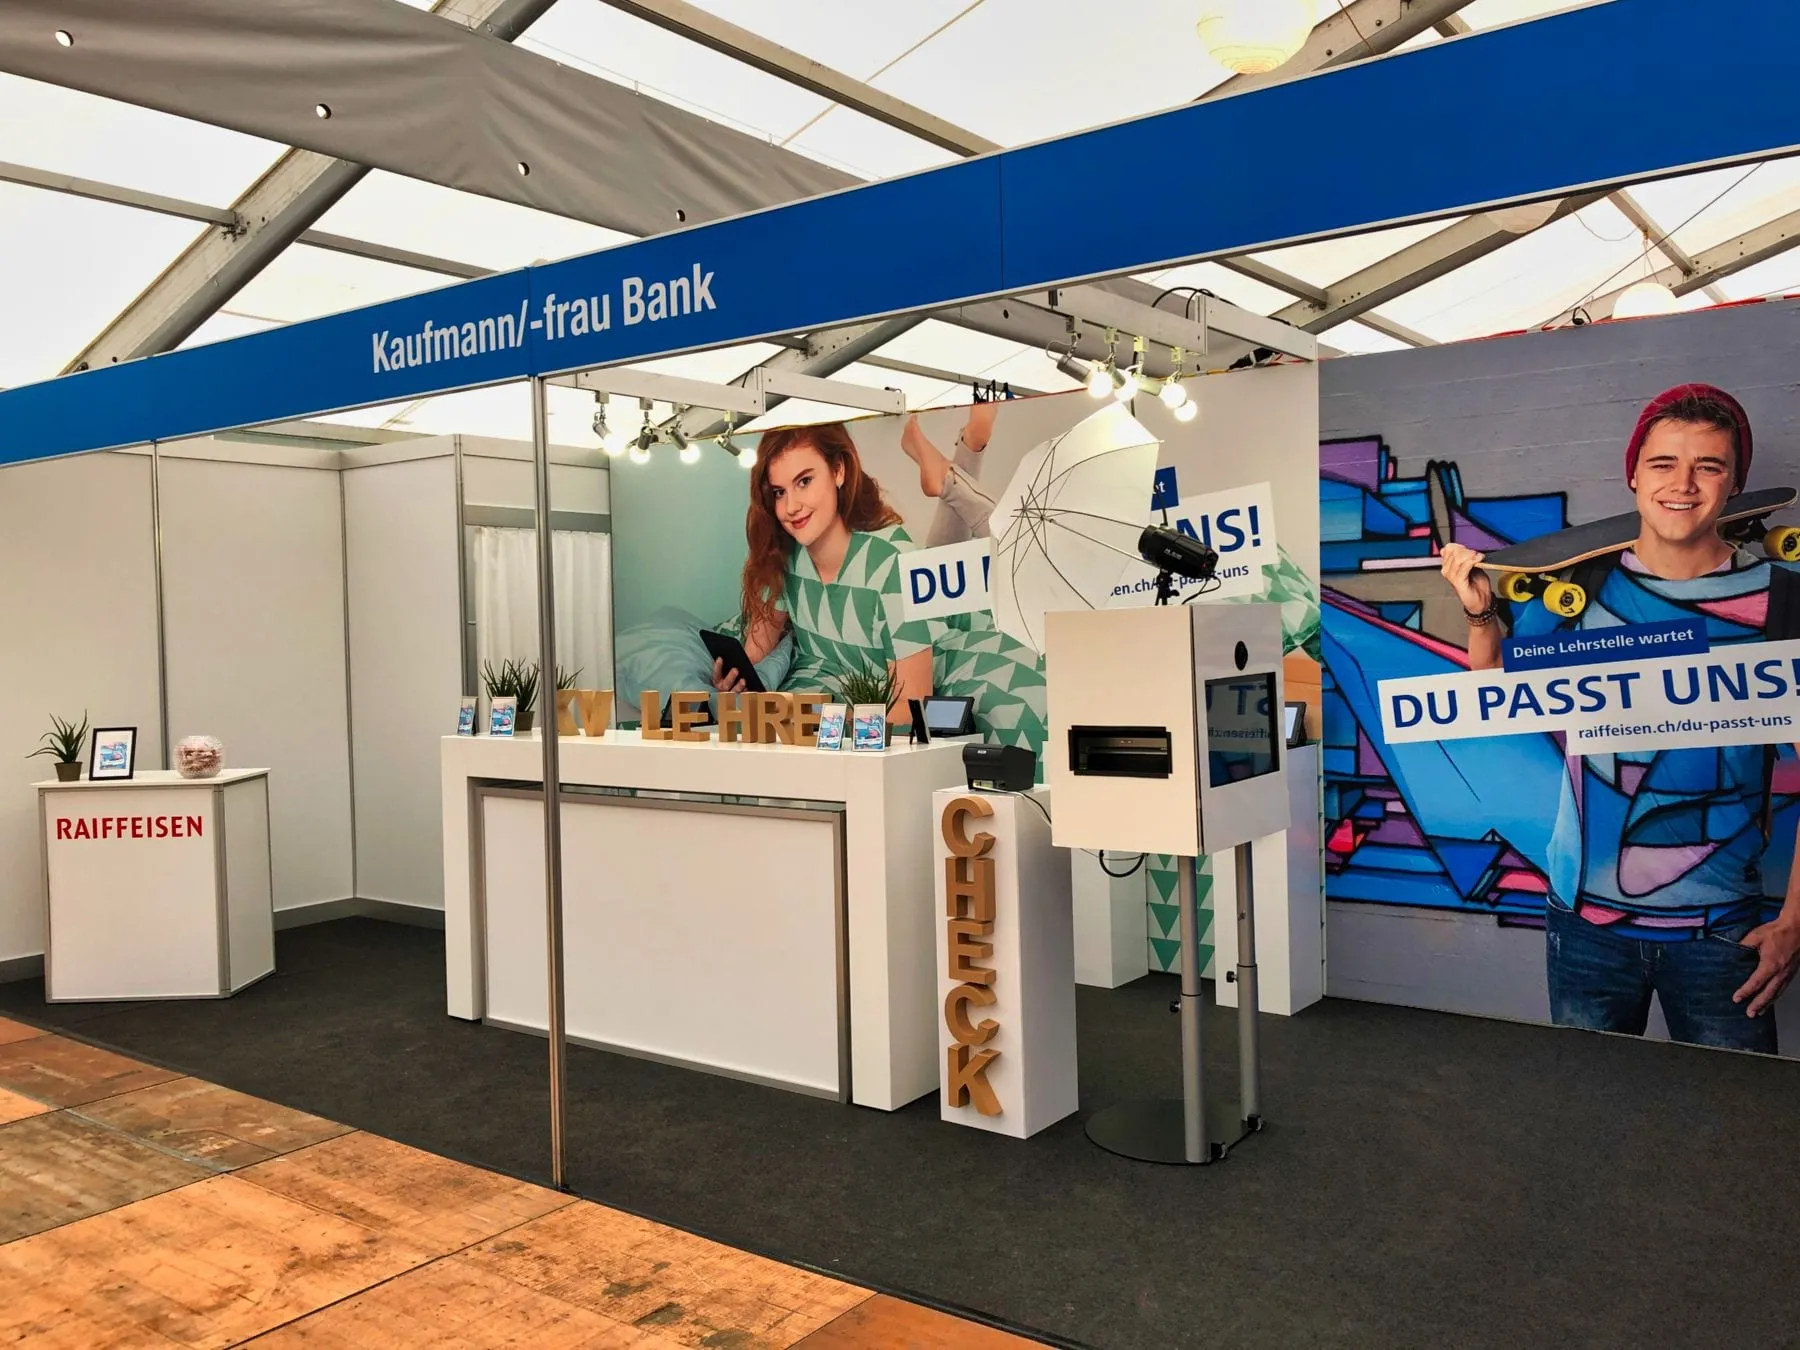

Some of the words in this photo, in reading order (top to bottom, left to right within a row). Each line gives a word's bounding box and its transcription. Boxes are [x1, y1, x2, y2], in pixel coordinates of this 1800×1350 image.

[373, 293, 610, 373] Kaufmann/-frau
[623, 262, 716, 326] Bank
[910, 560, 966, 605] DU
[1513, 644, 1555, 659] Deine
[1559, 634, 1634, 654] Lehrstelle
[1638, 628, 1694, 645] wartet
[1392, 689, 1458, 728] DU
[1478, 672, 1641, 721] PASST
[1578, 715, 1792, 739] raiffeisen.ch/du-passt-uns
[56, 815, 203, 840] RAIFFEISEN
[941, 796, 1002, 1117] CHECK
